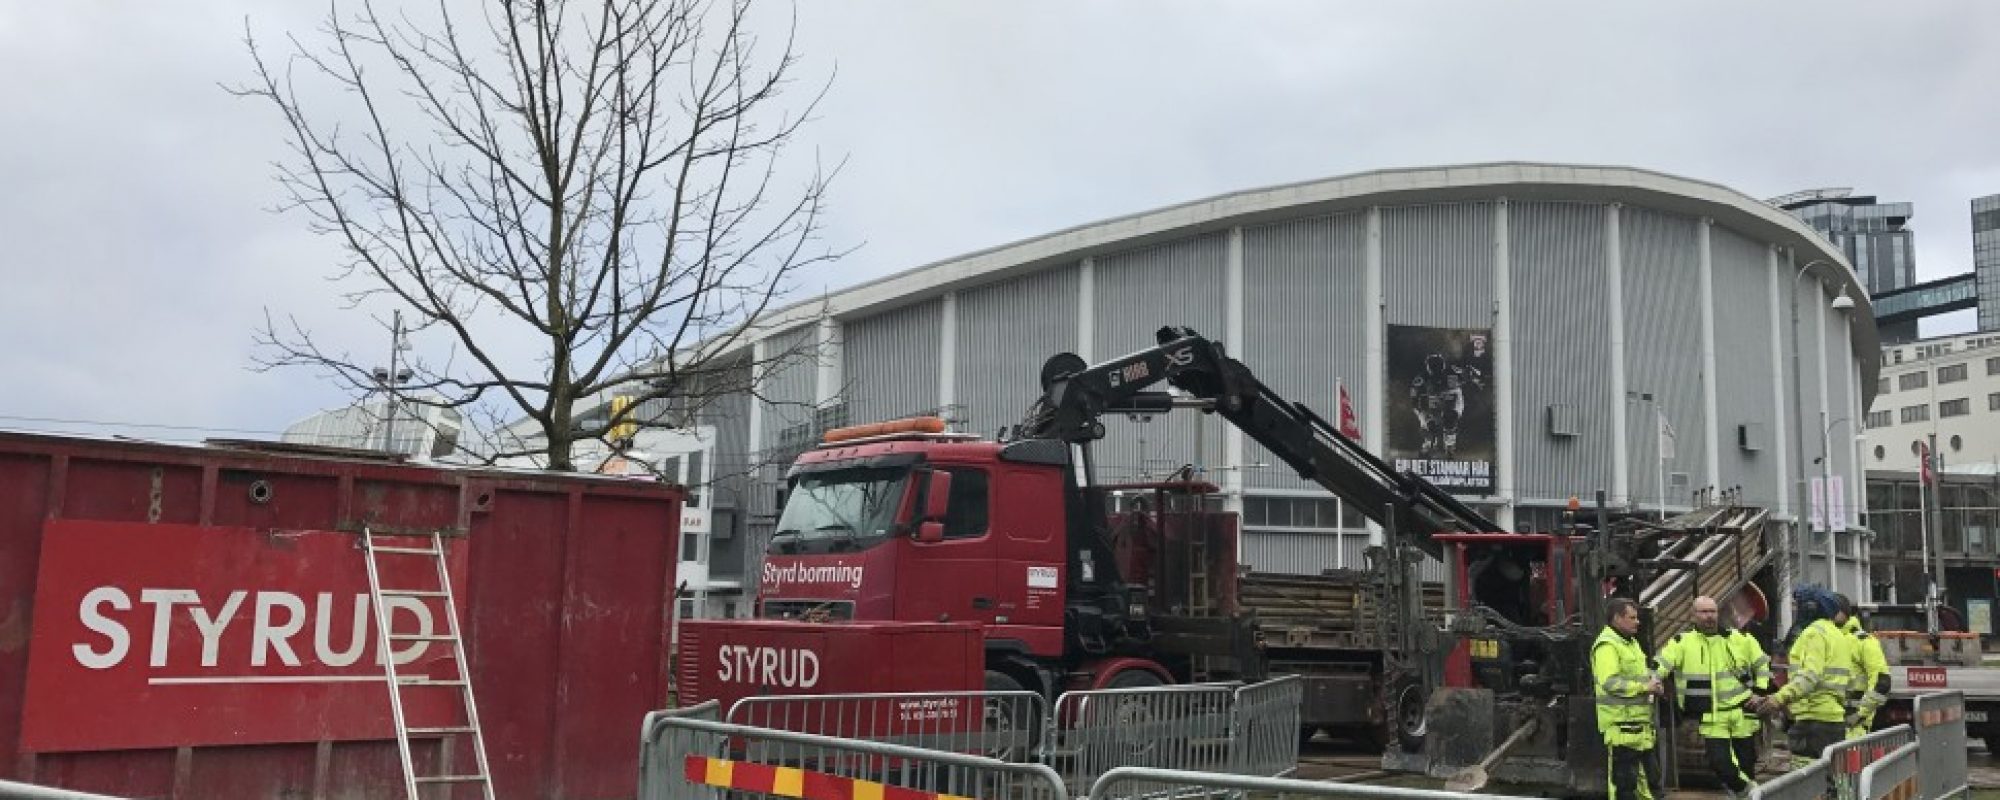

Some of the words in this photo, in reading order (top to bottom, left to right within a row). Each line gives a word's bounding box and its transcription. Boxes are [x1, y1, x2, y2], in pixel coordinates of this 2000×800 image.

[762, 561, 797, 589] Styrd
[71, 585, 434, 670] STYRUD
[717, 644, 820, 688] STYRUD
[1908, 671, 1945, 683] STYRUD
